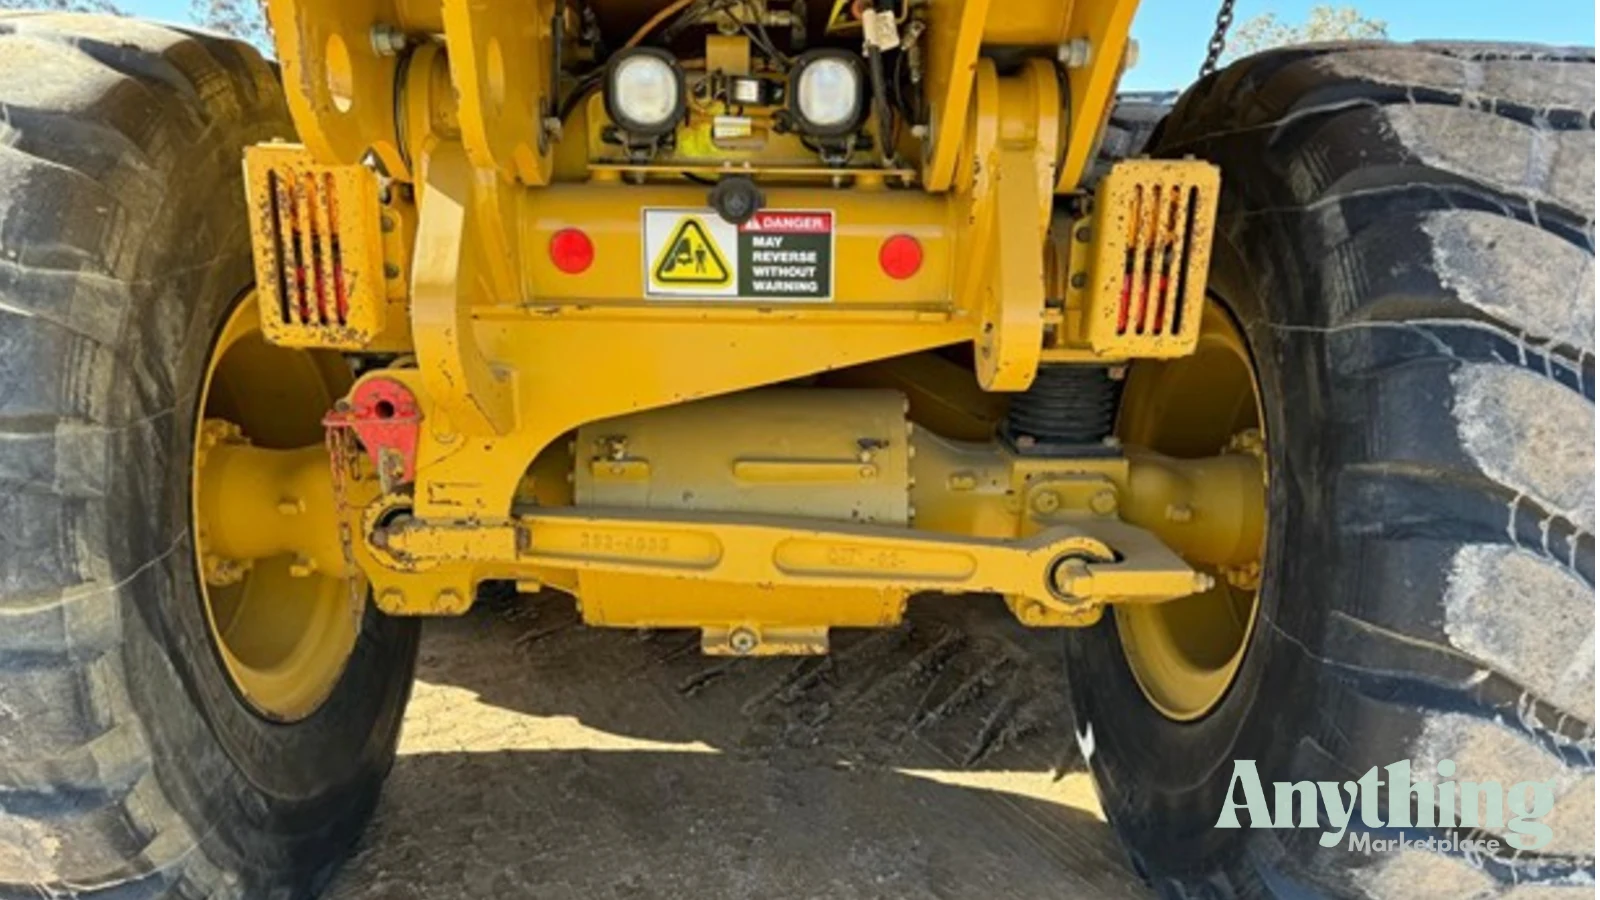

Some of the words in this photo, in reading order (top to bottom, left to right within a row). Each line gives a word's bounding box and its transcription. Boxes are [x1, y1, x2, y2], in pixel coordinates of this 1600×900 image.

[763, 216, 823, 228] DANGER
[752, 236, 783, 248] MAY
[752, 252, 817, 263] REVERSE
[752, 266, 816, 278] WITHOUT
[752, 281, 818, 292] WARNING
